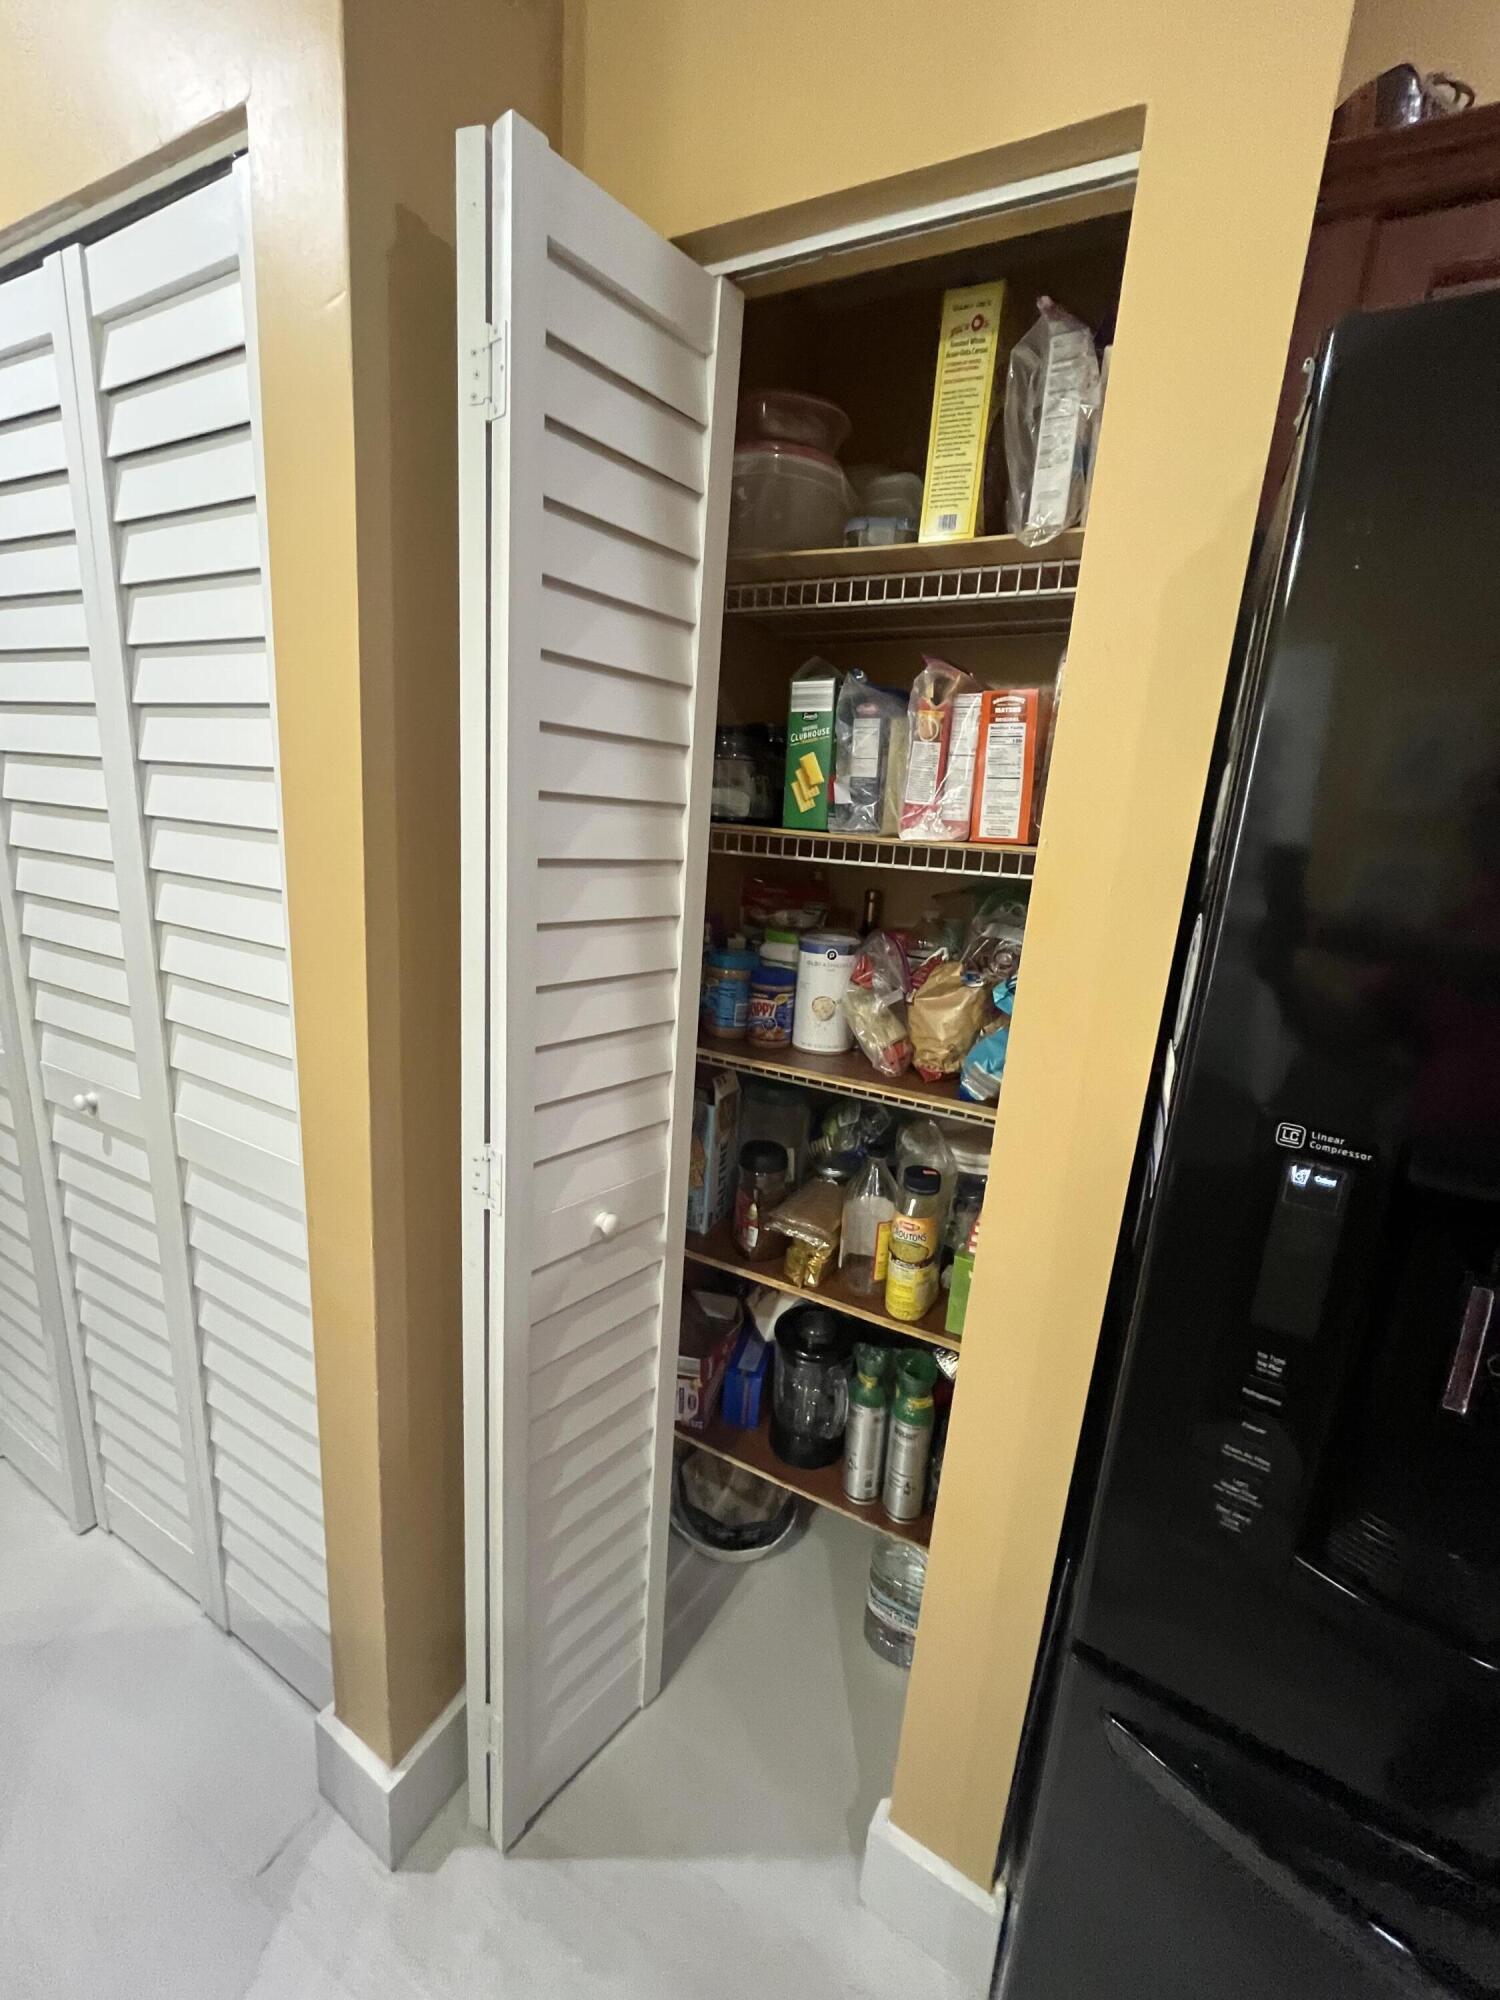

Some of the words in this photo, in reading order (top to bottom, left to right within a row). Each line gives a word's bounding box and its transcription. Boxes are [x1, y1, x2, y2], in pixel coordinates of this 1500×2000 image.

[790, 727, 831, 743] CLUBHOUSE
[1282, 1129, 1300, 1142] LC
[1311, 1131, 1345, 1145] Linear
[1309, 1141, 1373, 1161] Compressor
